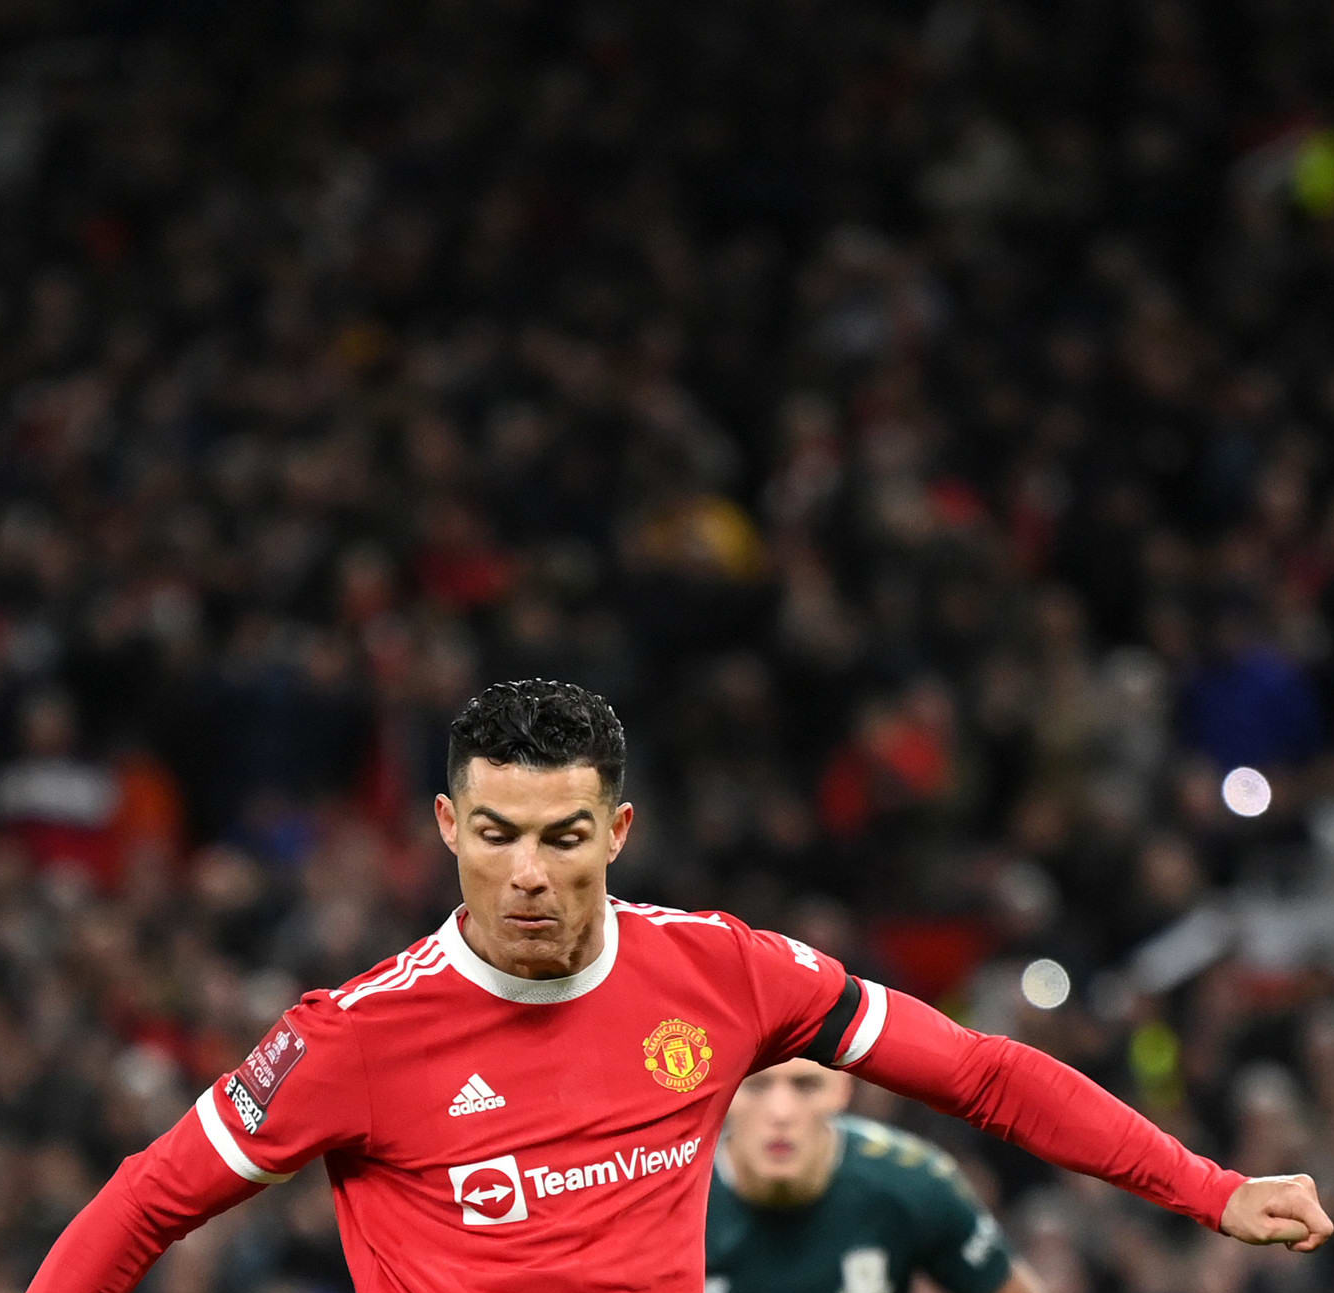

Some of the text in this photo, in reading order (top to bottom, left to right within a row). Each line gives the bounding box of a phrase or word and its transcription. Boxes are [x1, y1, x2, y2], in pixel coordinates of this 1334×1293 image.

[648, 1023, 703, 1053] MANCHESTER
[253, 1066, 272, 1088] CUP
[665, 1071, 702, 1088] UNITED
[234, 1083, 264, 1122] room
[448, 1095, 507, 1117] adidas
[524, 1137, 702, 1198] TeamViewer
